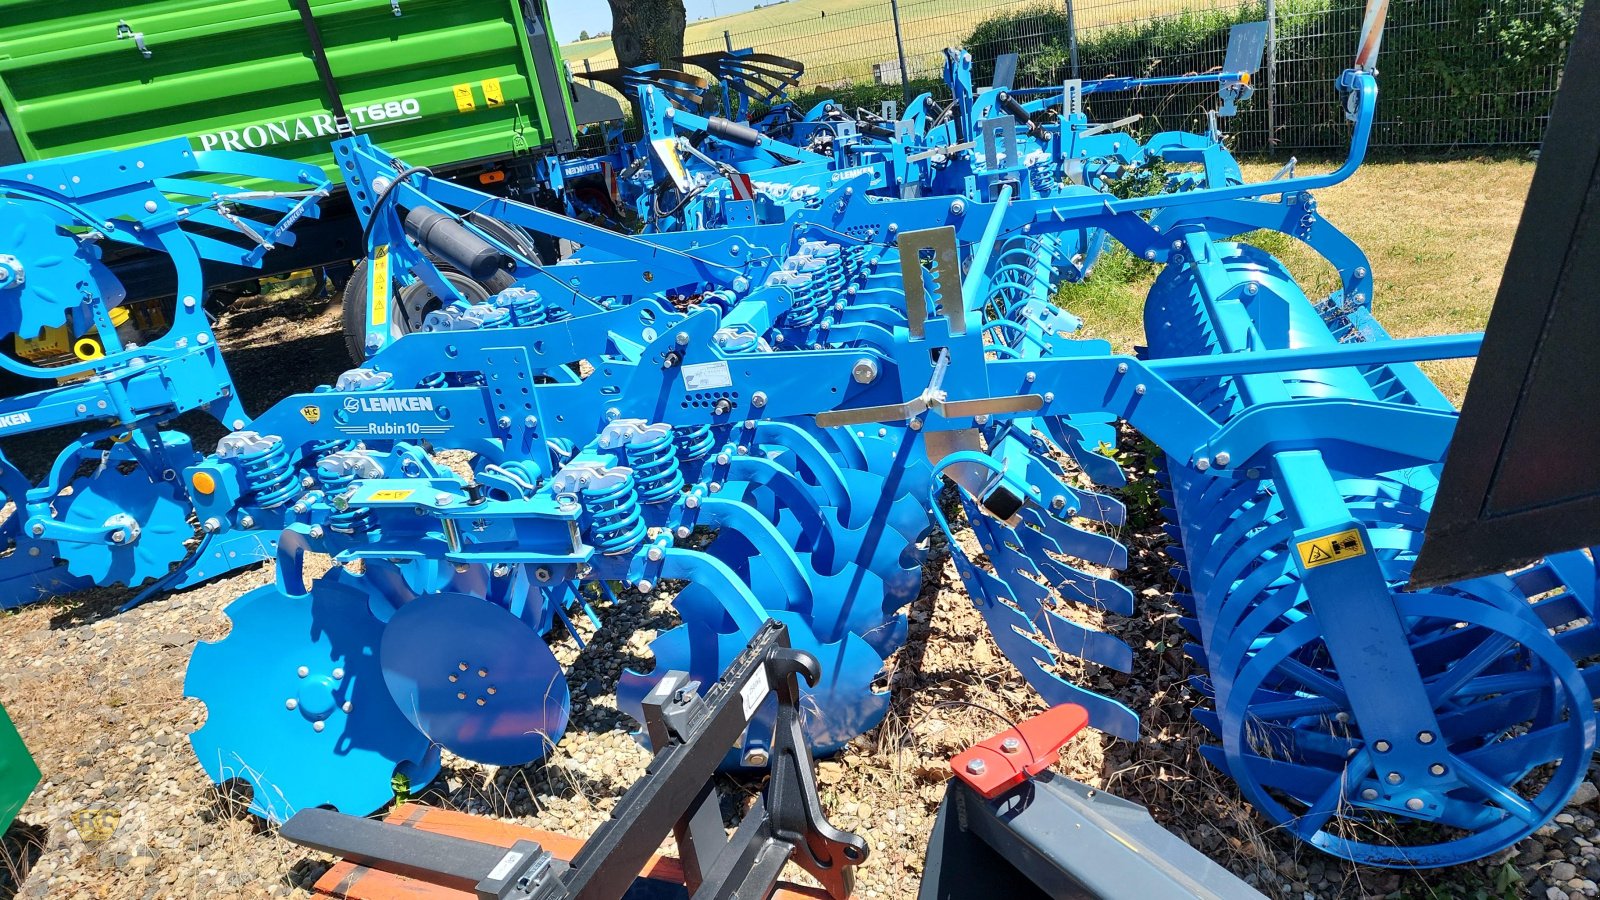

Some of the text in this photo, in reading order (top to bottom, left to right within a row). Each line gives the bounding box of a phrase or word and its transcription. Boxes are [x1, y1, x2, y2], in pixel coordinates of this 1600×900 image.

[350, 98, 420, 123] T680
[199, 113, 336, 151] PRONAR
[565, 162, 600, 176] LEMKEN
[280, 205, 305, 232] LEMKEN
[360, 397, 434, 413] LEMKEN
[368, 422, 420, 435] Rubin 10
